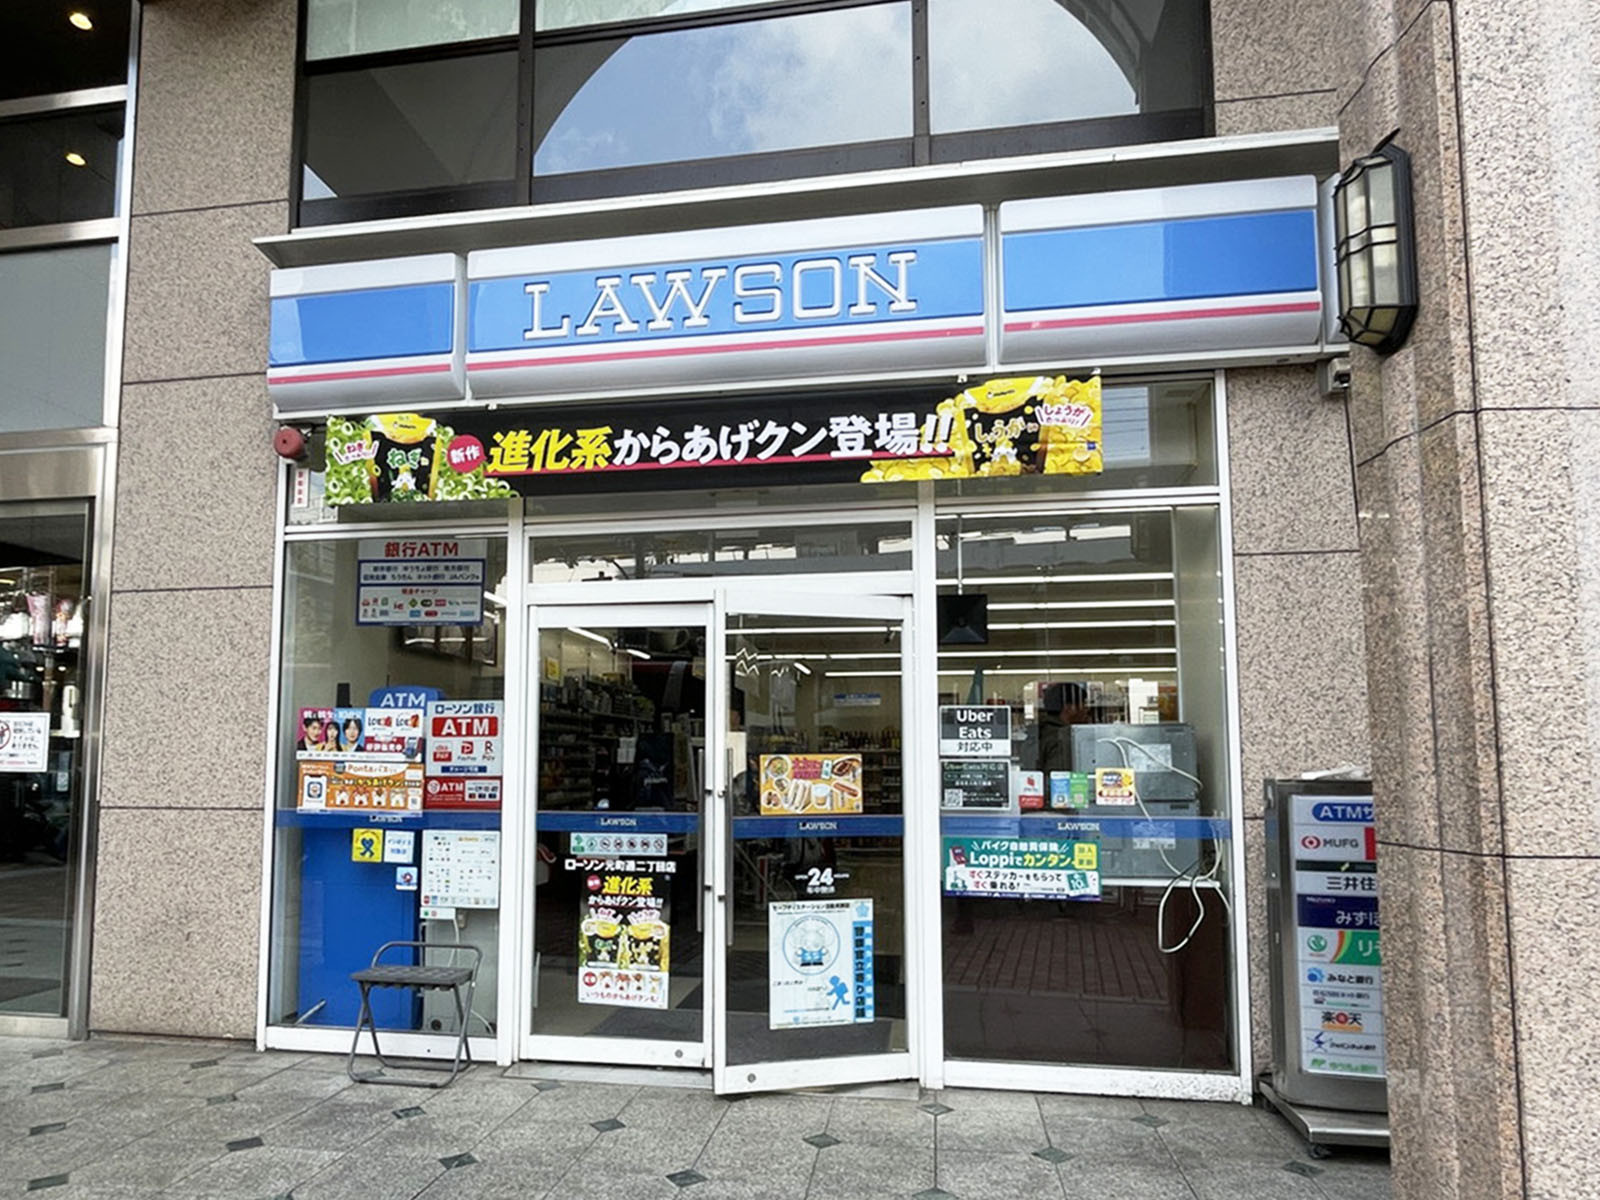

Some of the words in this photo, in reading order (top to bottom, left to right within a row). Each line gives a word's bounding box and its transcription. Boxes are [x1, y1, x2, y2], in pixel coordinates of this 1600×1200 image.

[523, 250, 918, 340] LAWSON
[1044, 405, 1084, 416] しょうが
[975, 416, 1026, 442] しょうが
[345, 442, 364, 453] ねぎ
[451, 446, 480, 464] 新作
[487, 412, 954, 474] 進化系からあげクン登場!!
[386, 448, 422, 469] ねぎ
[384, 541, 459, 557] 銀行ATM
[380, 693, 426, 707] ATM
[435, 703, 495, 714] ローソン銀行
[956, 709, 994, 723] Uber
[440, 718, 490, 736] ATM
[959, 726, 992, 739] Eats
[957, 742, 993, 752] 対応中
[441, 783, 463, 792] ATM
[1323, 839, 1359, 848] MUFG
[970, 851, 1071, 868] Loppiでカンタン
[808, 867, 834, 885] 24
[1326, 876, 1376, 891] 三井住
[602, 876, 653, 895] 進化系
[588, 895, 664, 908] からあげクン登場!!
[1358, 939, 1380, 957] リ
